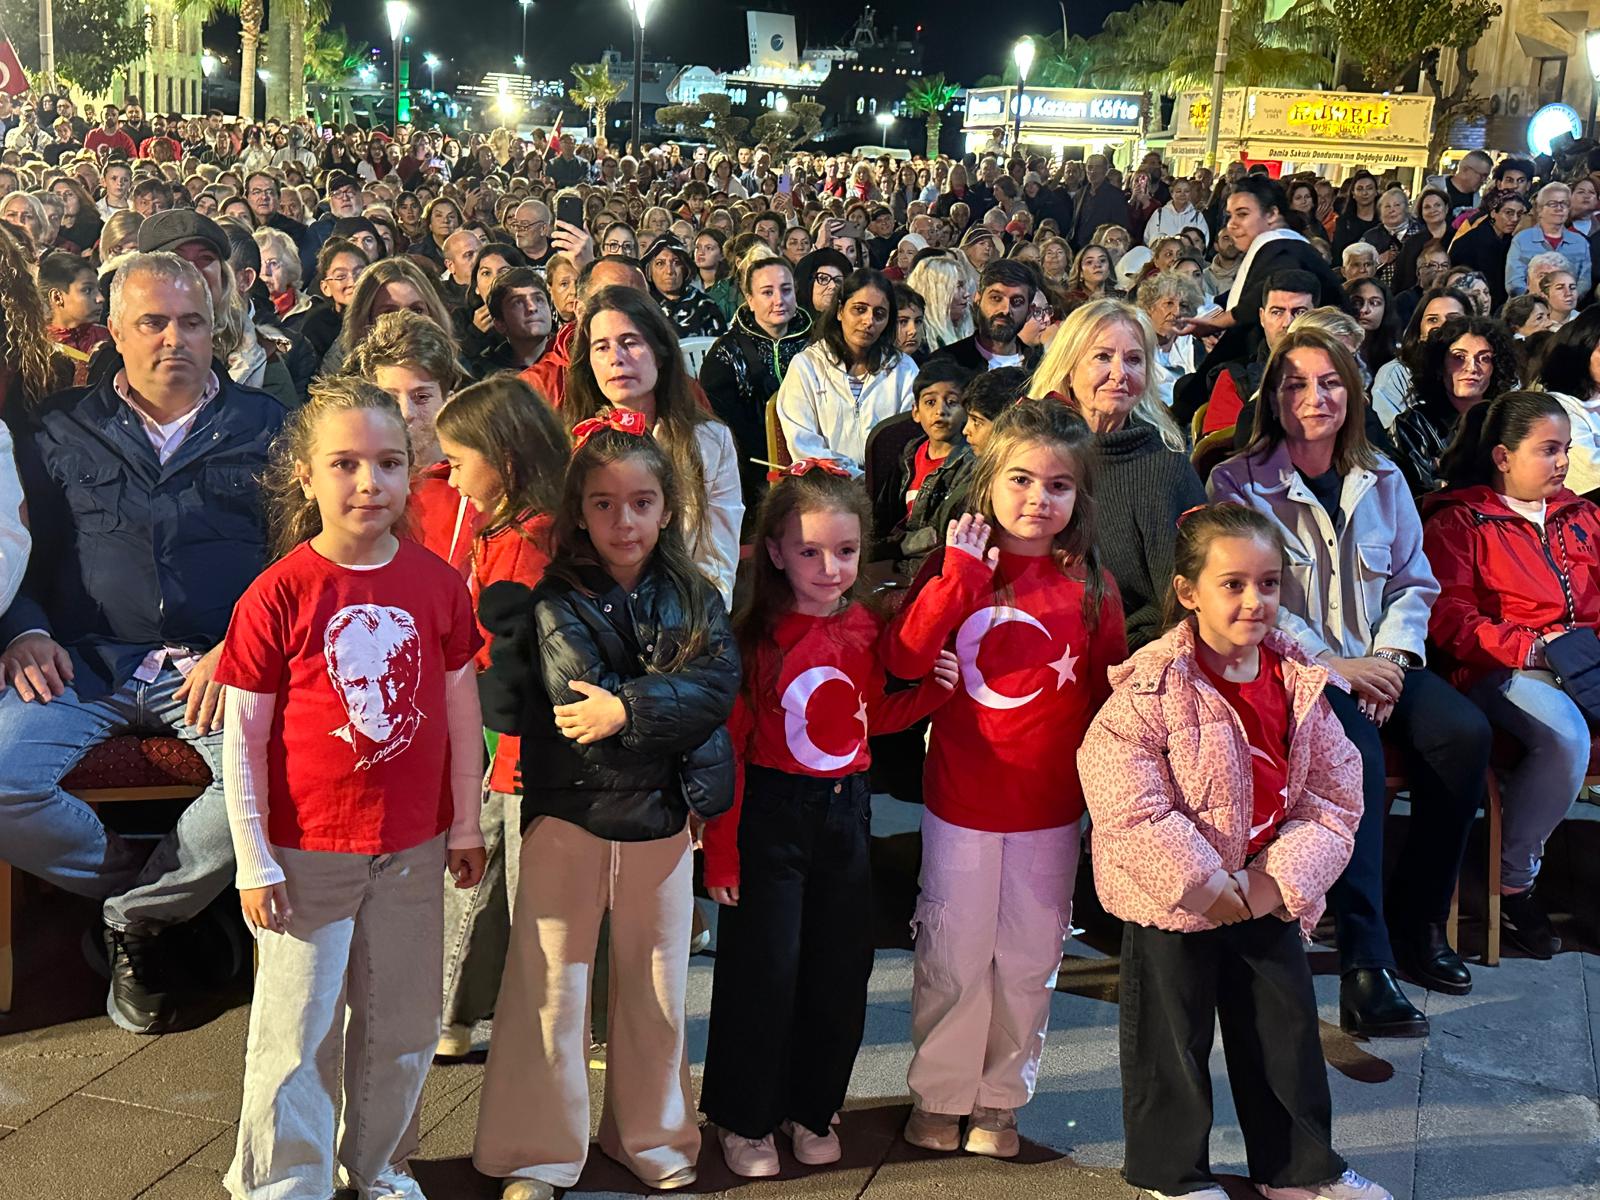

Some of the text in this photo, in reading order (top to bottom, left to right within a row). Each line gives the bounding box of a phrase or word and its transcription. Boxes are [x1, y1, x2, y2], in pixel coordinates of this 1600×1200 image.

[1031, 96, 1139, 120] Kazan Köfte
[1268, 149, 1288, 158] Damla
